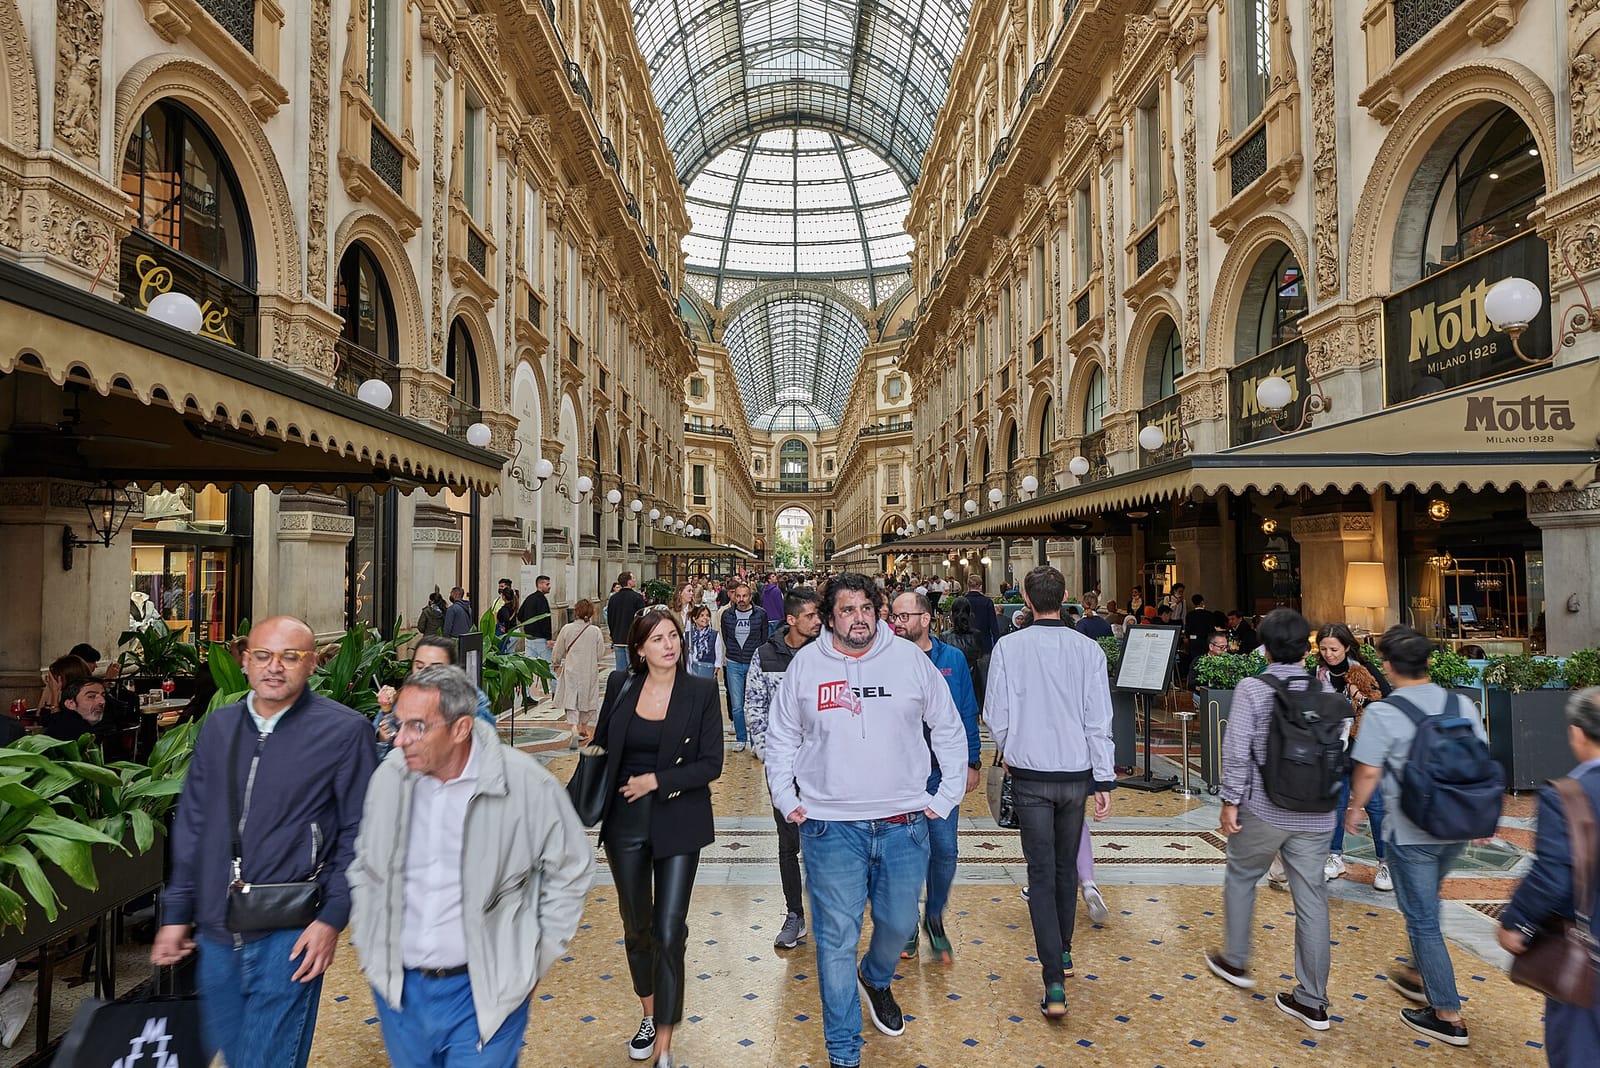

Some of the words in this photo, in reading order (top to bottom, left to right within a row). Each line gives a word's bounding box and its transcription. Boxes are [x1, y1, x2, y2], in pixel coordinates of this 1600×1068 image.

[1408, 276, 1513, 363] Mott
[1427, 353, 1467, 375] MILANO
[1468, 342, 1498, 361] 1928
[1464, 394, 1576, 432] Motta
[1486, 436, 1526, 444] MILANO
[1528, 435, 1555, 443] 1928
